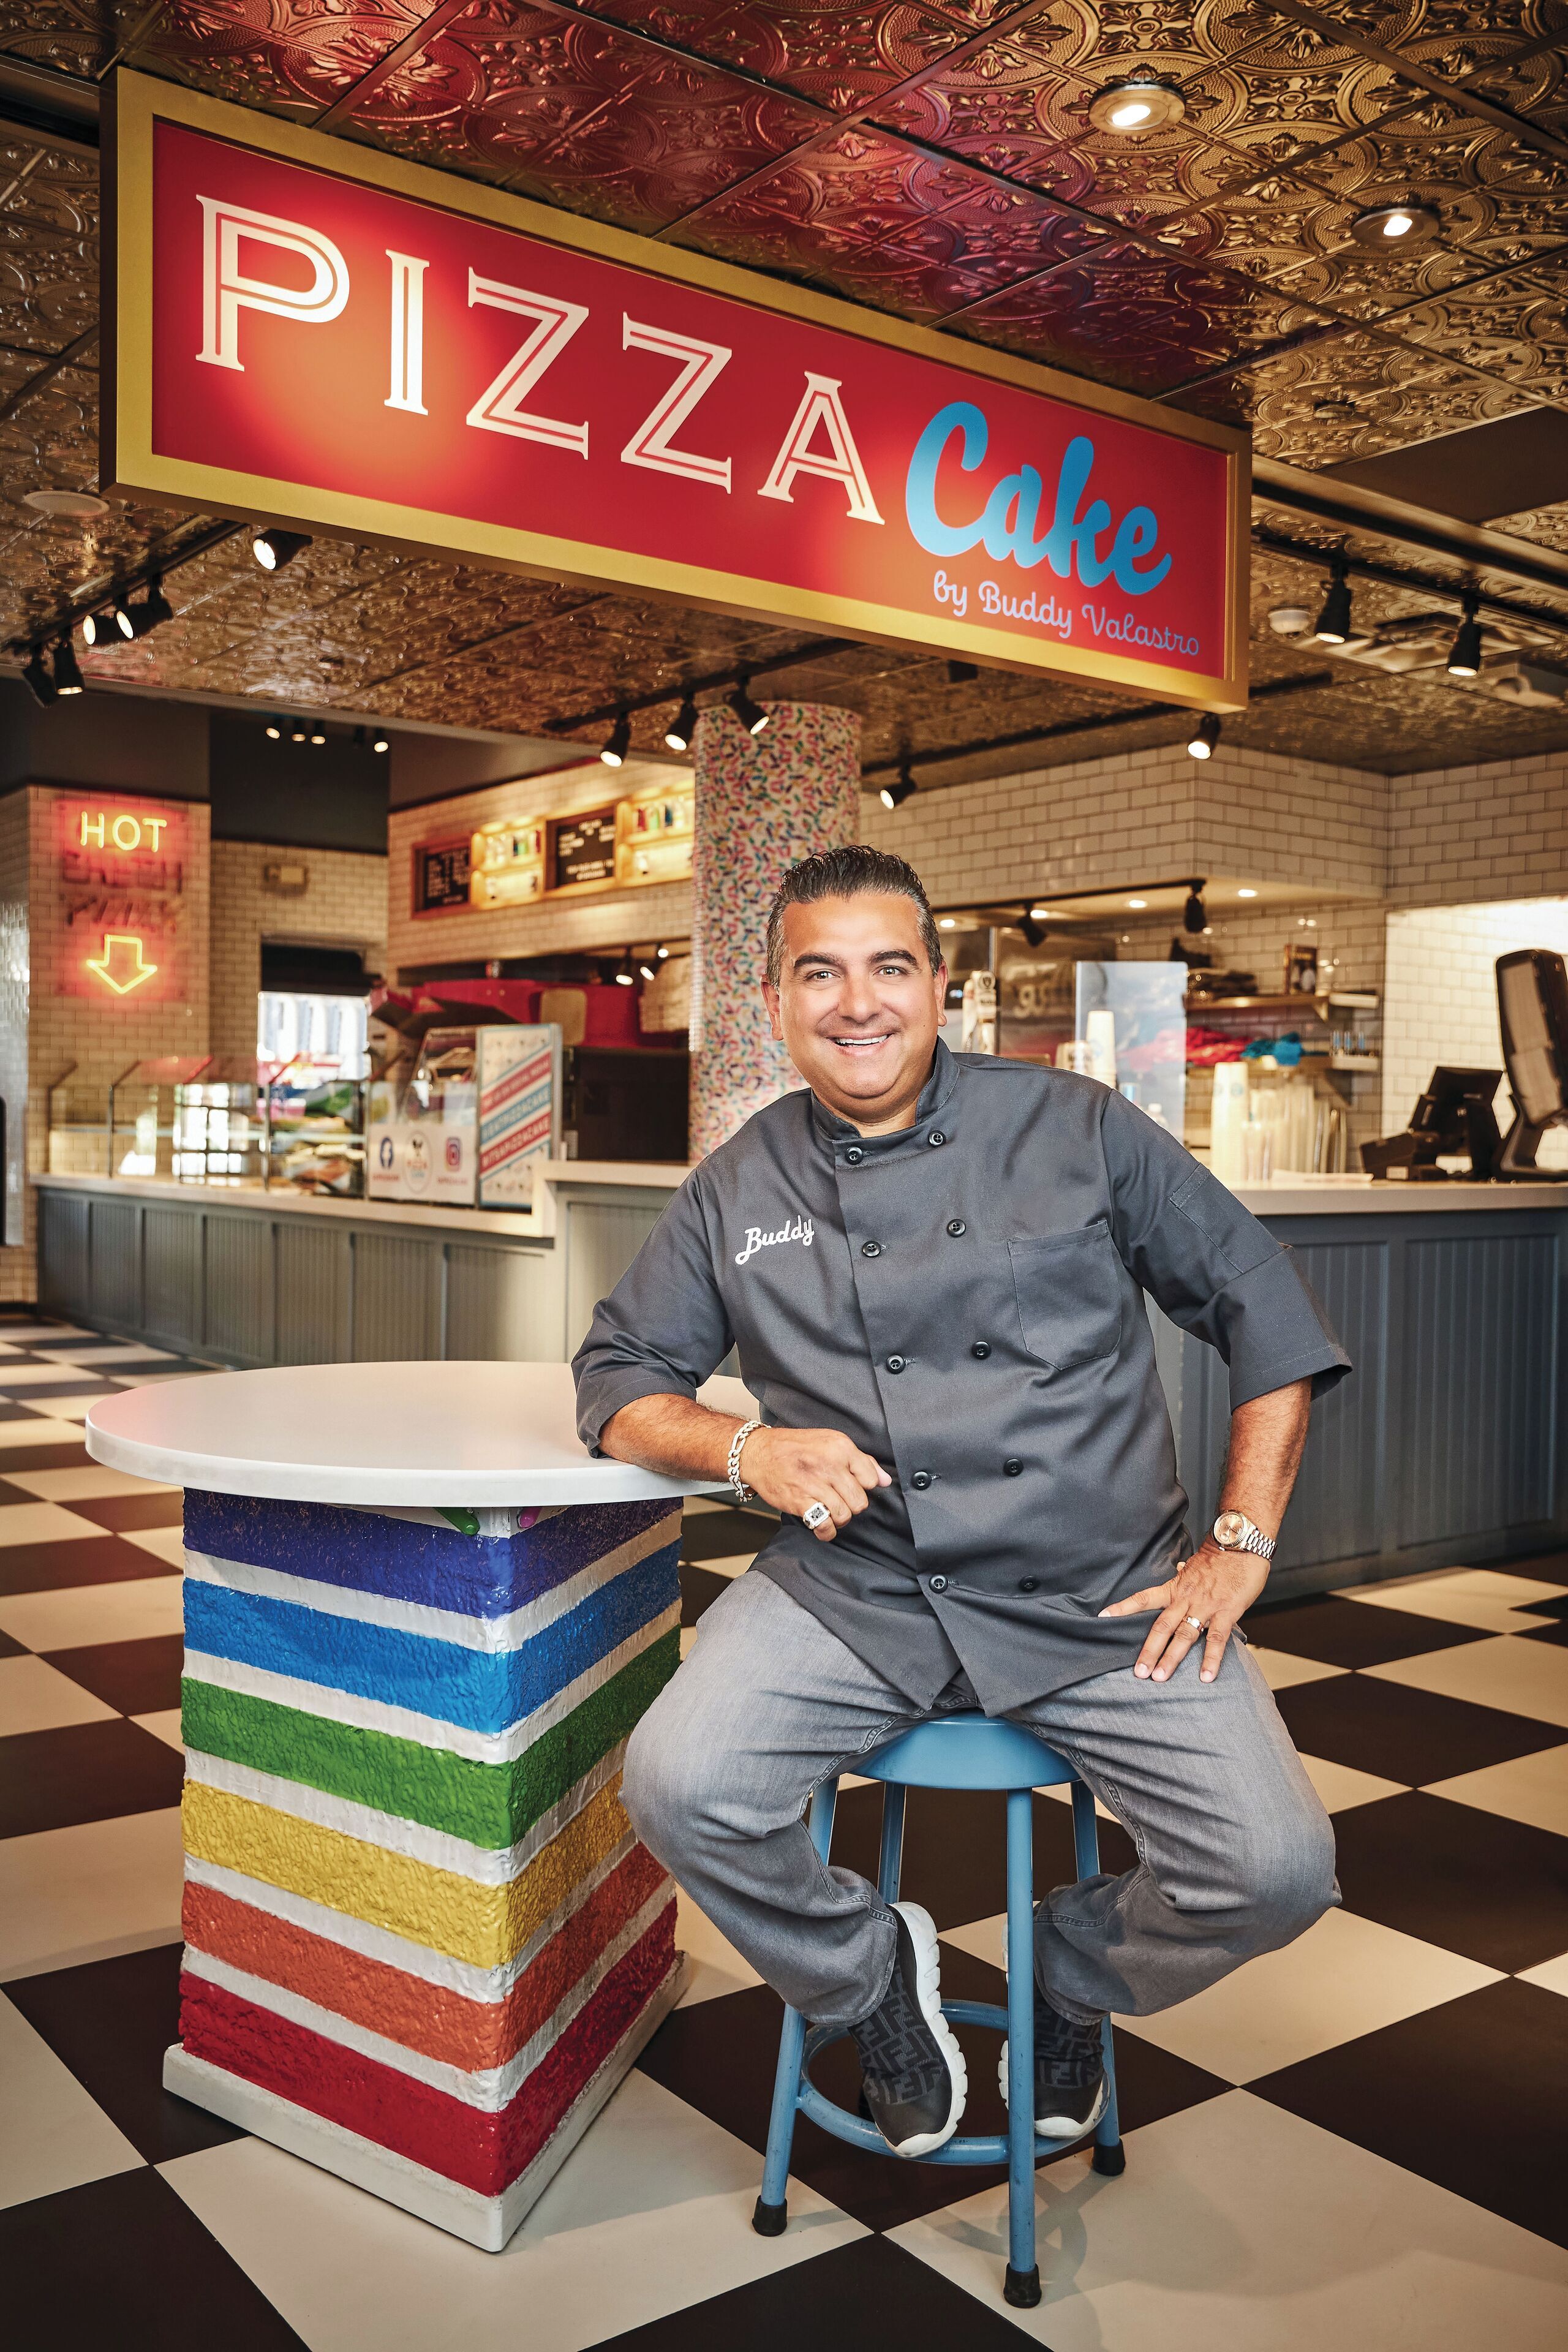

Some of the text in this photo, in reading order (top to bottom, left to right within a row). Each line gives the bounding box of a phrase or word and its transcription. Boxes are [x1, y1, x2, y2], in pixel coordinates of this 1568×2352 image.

[196, 194, 1172, 595] PIZZA Cake
[934, 570, 1199, 656] by Buddy Valastro
[80, 812, 167, 853] HOT
[735, 1215, 815, 1265] Buddy
